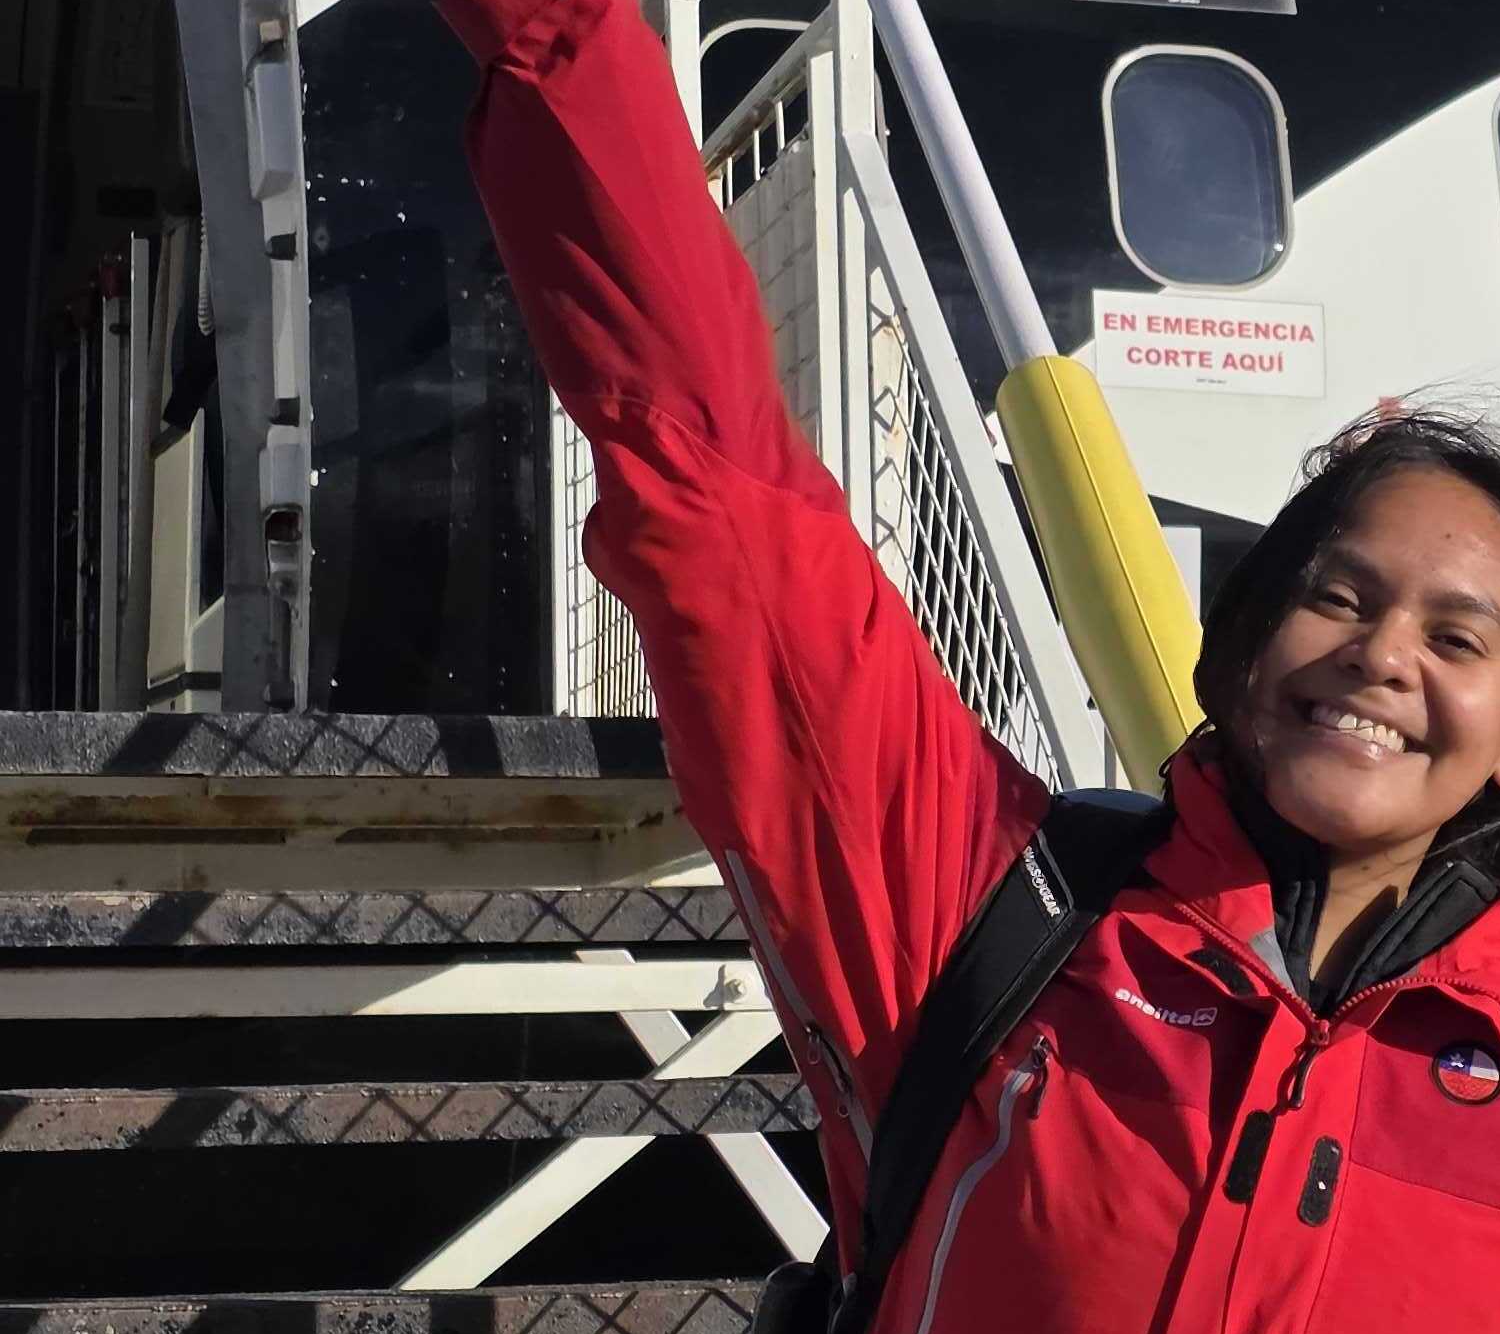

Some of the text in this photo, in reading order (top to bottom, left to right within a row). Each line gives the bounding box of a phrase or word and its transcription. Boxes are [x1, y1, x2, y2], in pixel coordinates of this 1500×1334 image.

[1103, 313, 1315, 342] EN EMERGENCIA
[1127, 346, 1284, 373] CORTE AQUÍ
